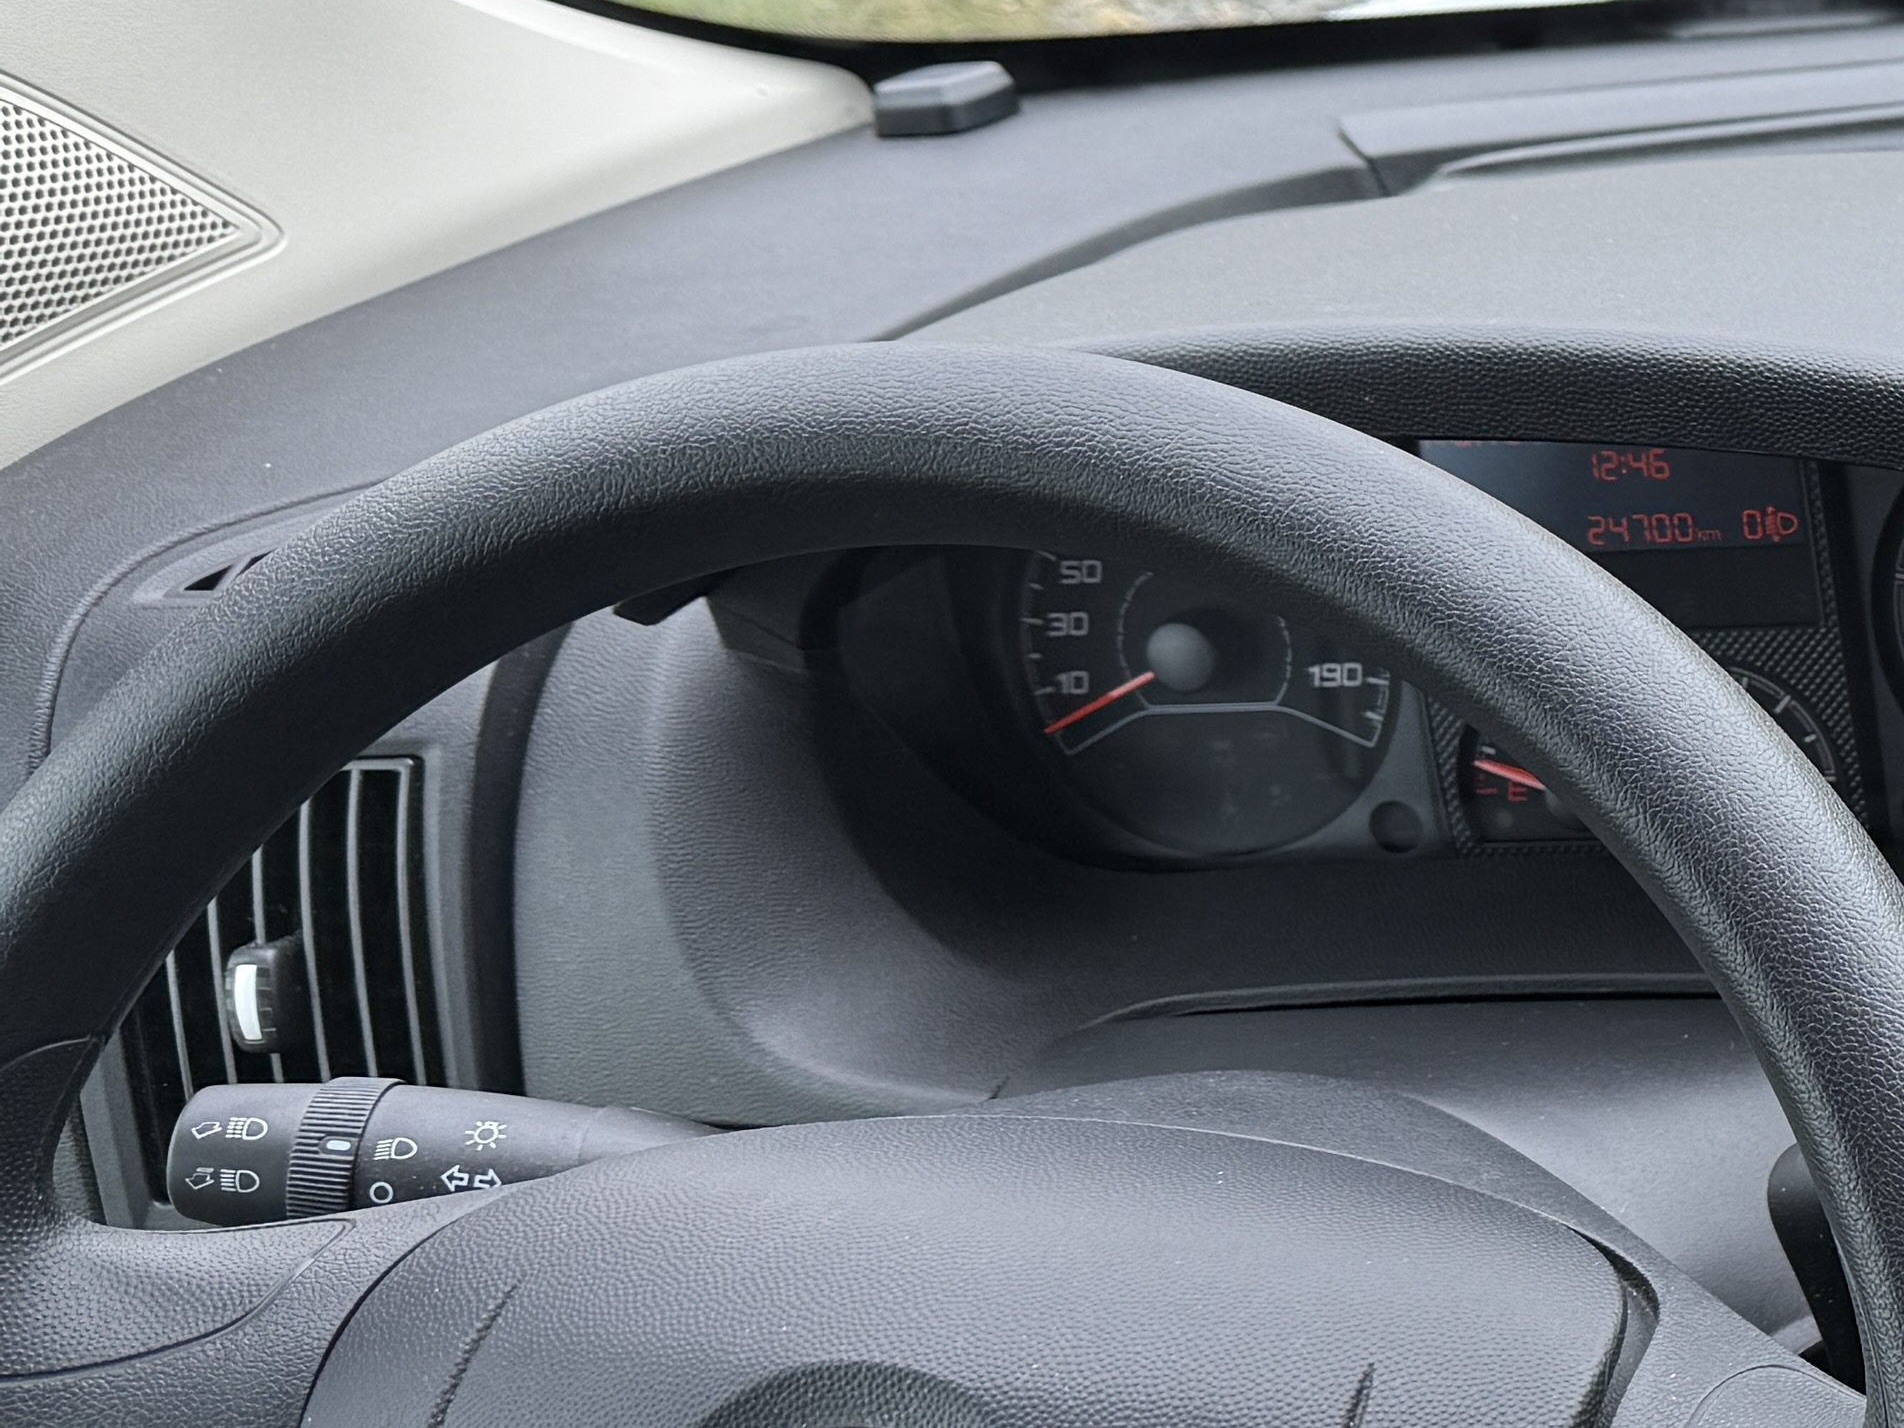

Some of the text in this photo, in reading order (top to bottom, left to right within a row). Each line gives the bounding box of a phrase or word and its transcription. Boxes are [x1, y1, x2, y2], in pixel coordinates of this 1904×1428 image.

[1591, 449, 1672, 482] 12:46
[1059, 559, 1103, 585] 50
[1047, 611, 1089, 637] 30
[1053, 670, 1090, 695] 10
[1307, 662, 1363, 688] 190
